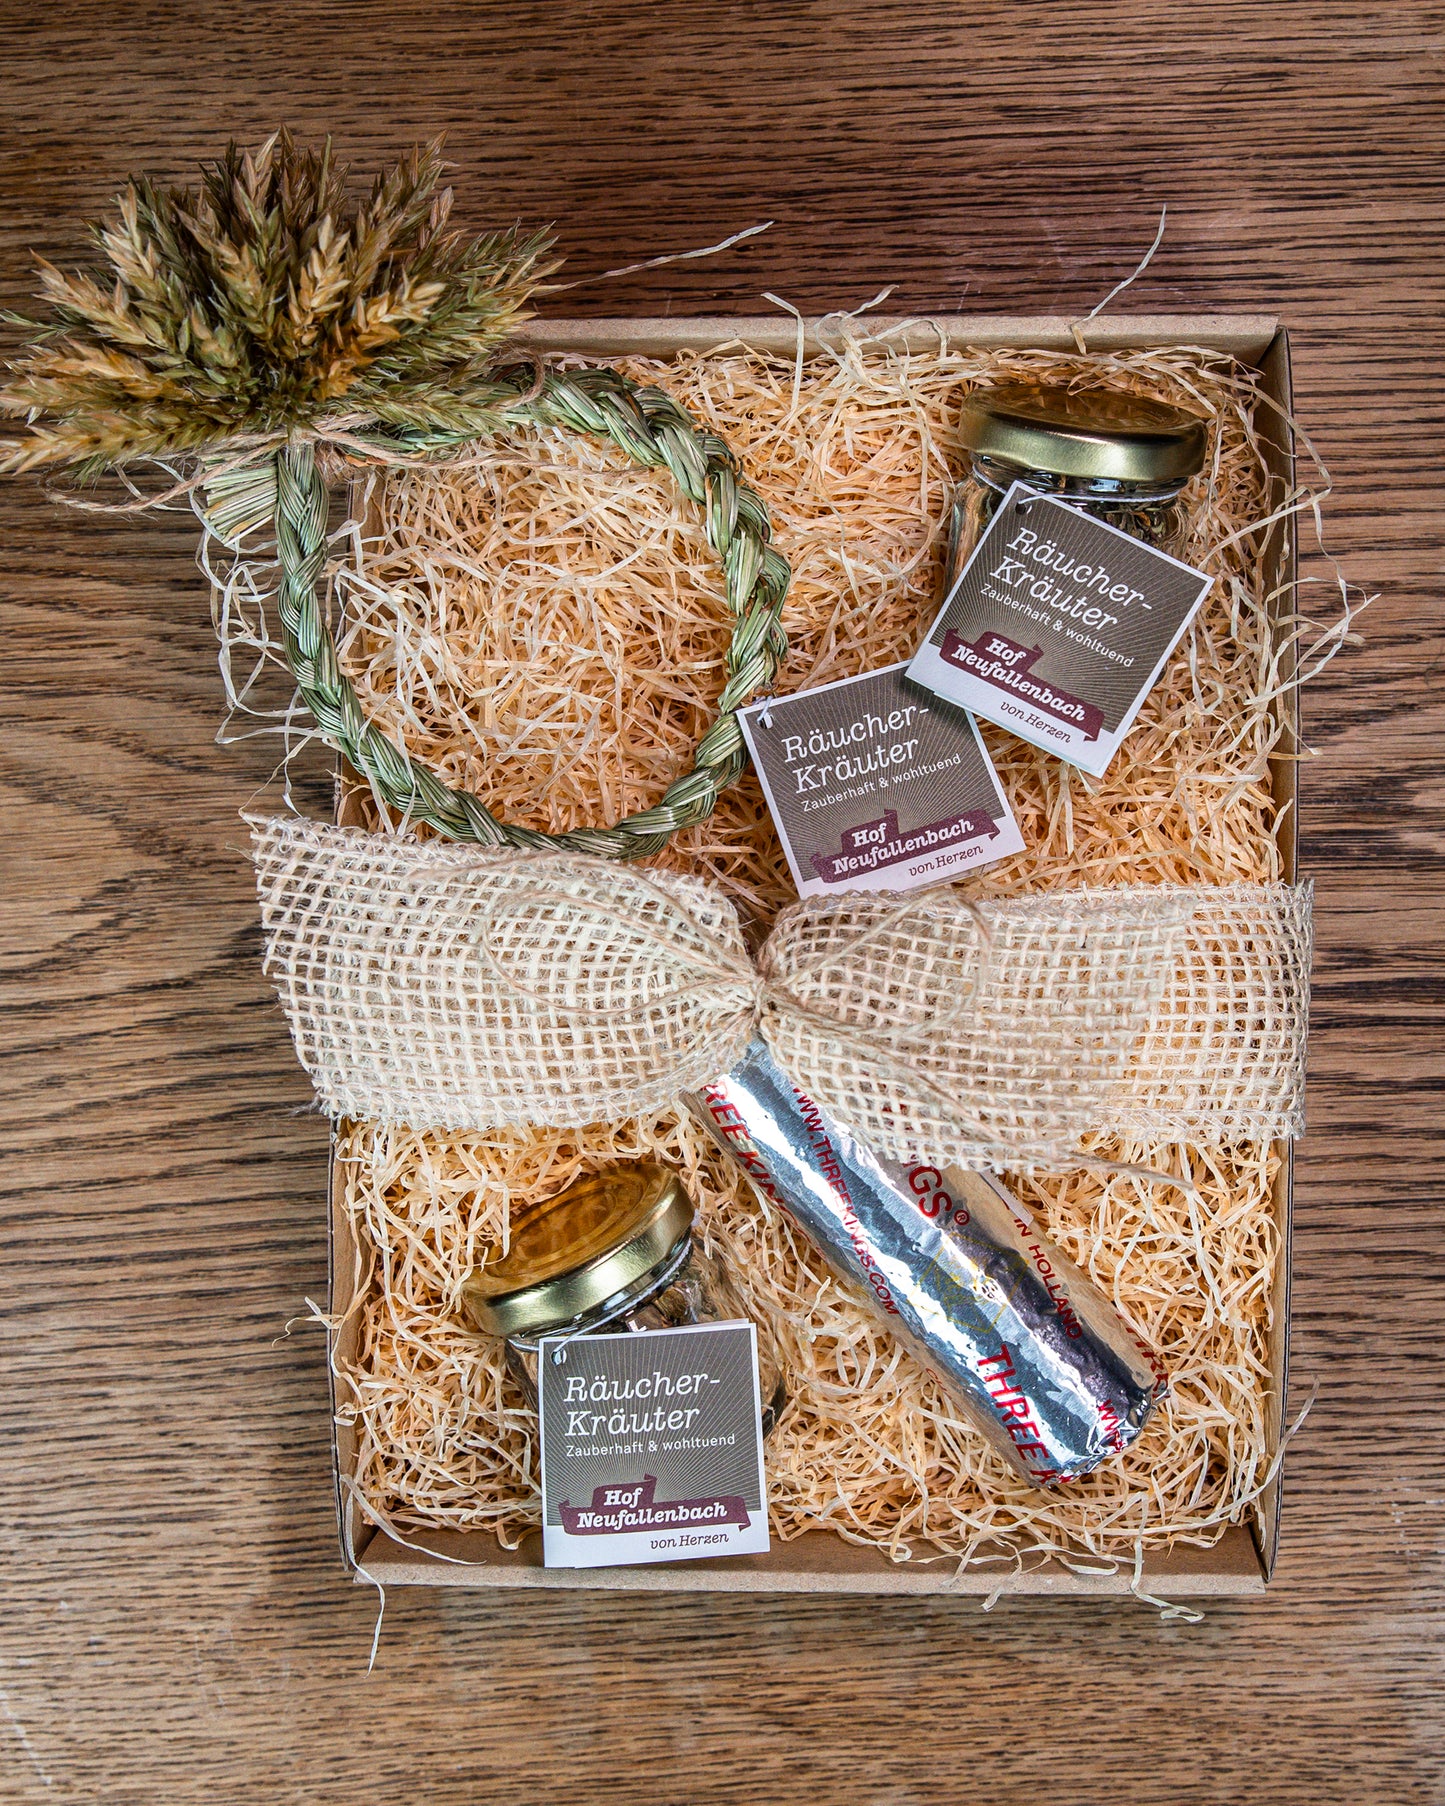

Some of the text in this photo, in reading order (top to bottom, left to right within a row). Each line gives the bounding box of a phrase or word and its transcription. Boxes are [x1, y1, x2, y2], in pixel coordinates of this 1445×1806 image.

[989, 555, 1118, 631] Kräuter
[1006, 527, 1154, 611] Räucher-
[980, 583, 1135, 668] Zauberhaft & wohltuend
[985, 638, 1027, 665] Hof
[951, 644, 1086, 722] Neufallenbach
[781, 704, 929, 763] Räucher-
[1000, 700, 1072, 744] von Herzen
[791, 737, 919, 794] Kräuter
[801, 753, 962, 812] Zauberhaft & wohltuend
[832, 818, 975, 875] Neufallenbach
[851, 823, 888, 848] Hof
[908, 844, 984, 877] von Herzen
[701, 1080, 753, 1143] REE
[791, 1083, 900, 1315] WW.THREEKINGS.COM
[1028, 1244, 1083, 1341] HOLLAND
[563, 1371, 721, 1402] Räucher-
[976, 1344, 1049, 1461] THREE
[564, 1407, 700, 1437] Kräuter
[566, 1433, 736, 1457] Zauberhaft & wohltuend
[576, 1502, 728, 1530] Neufallenbach
[603, 1486, 643, 1507] Hof
[650, 1532, 729, 1550] von Herzen
